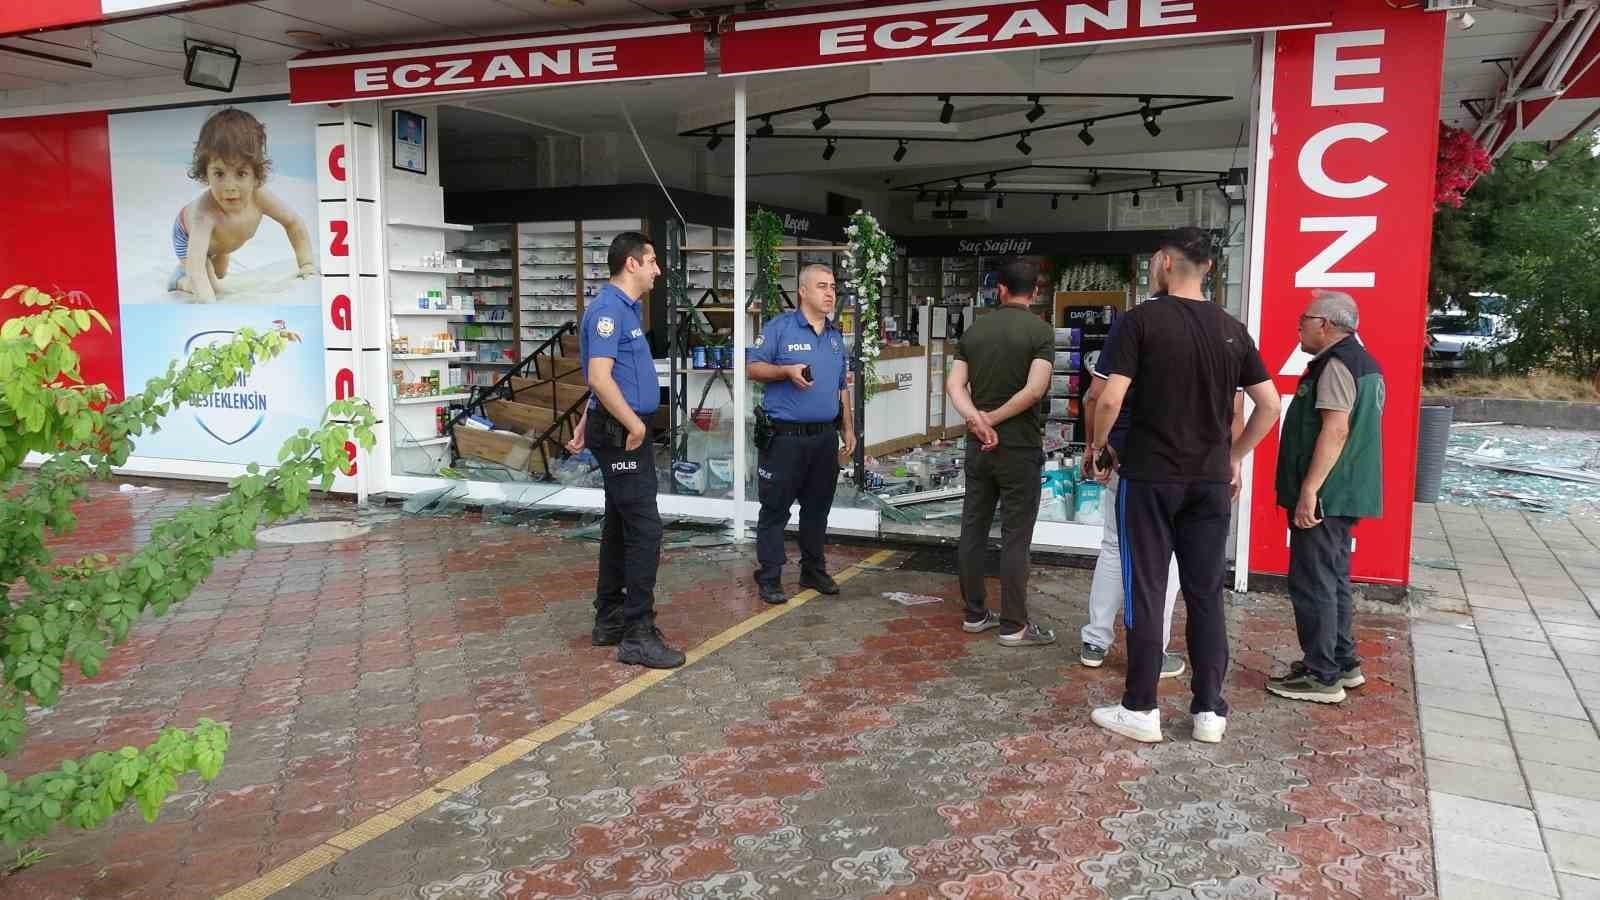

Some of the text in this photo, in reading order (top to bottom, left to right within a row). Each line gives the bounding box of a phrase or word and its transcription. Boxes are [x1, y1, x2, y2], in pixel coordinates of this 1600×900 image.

[820, 0, 1198, 56] ECZANE
[354, 45, 618, 93] ECZANE
[959, 238, 1032, 255] Saç Sağlığı
[611, 460, 638, 473] POLIS
